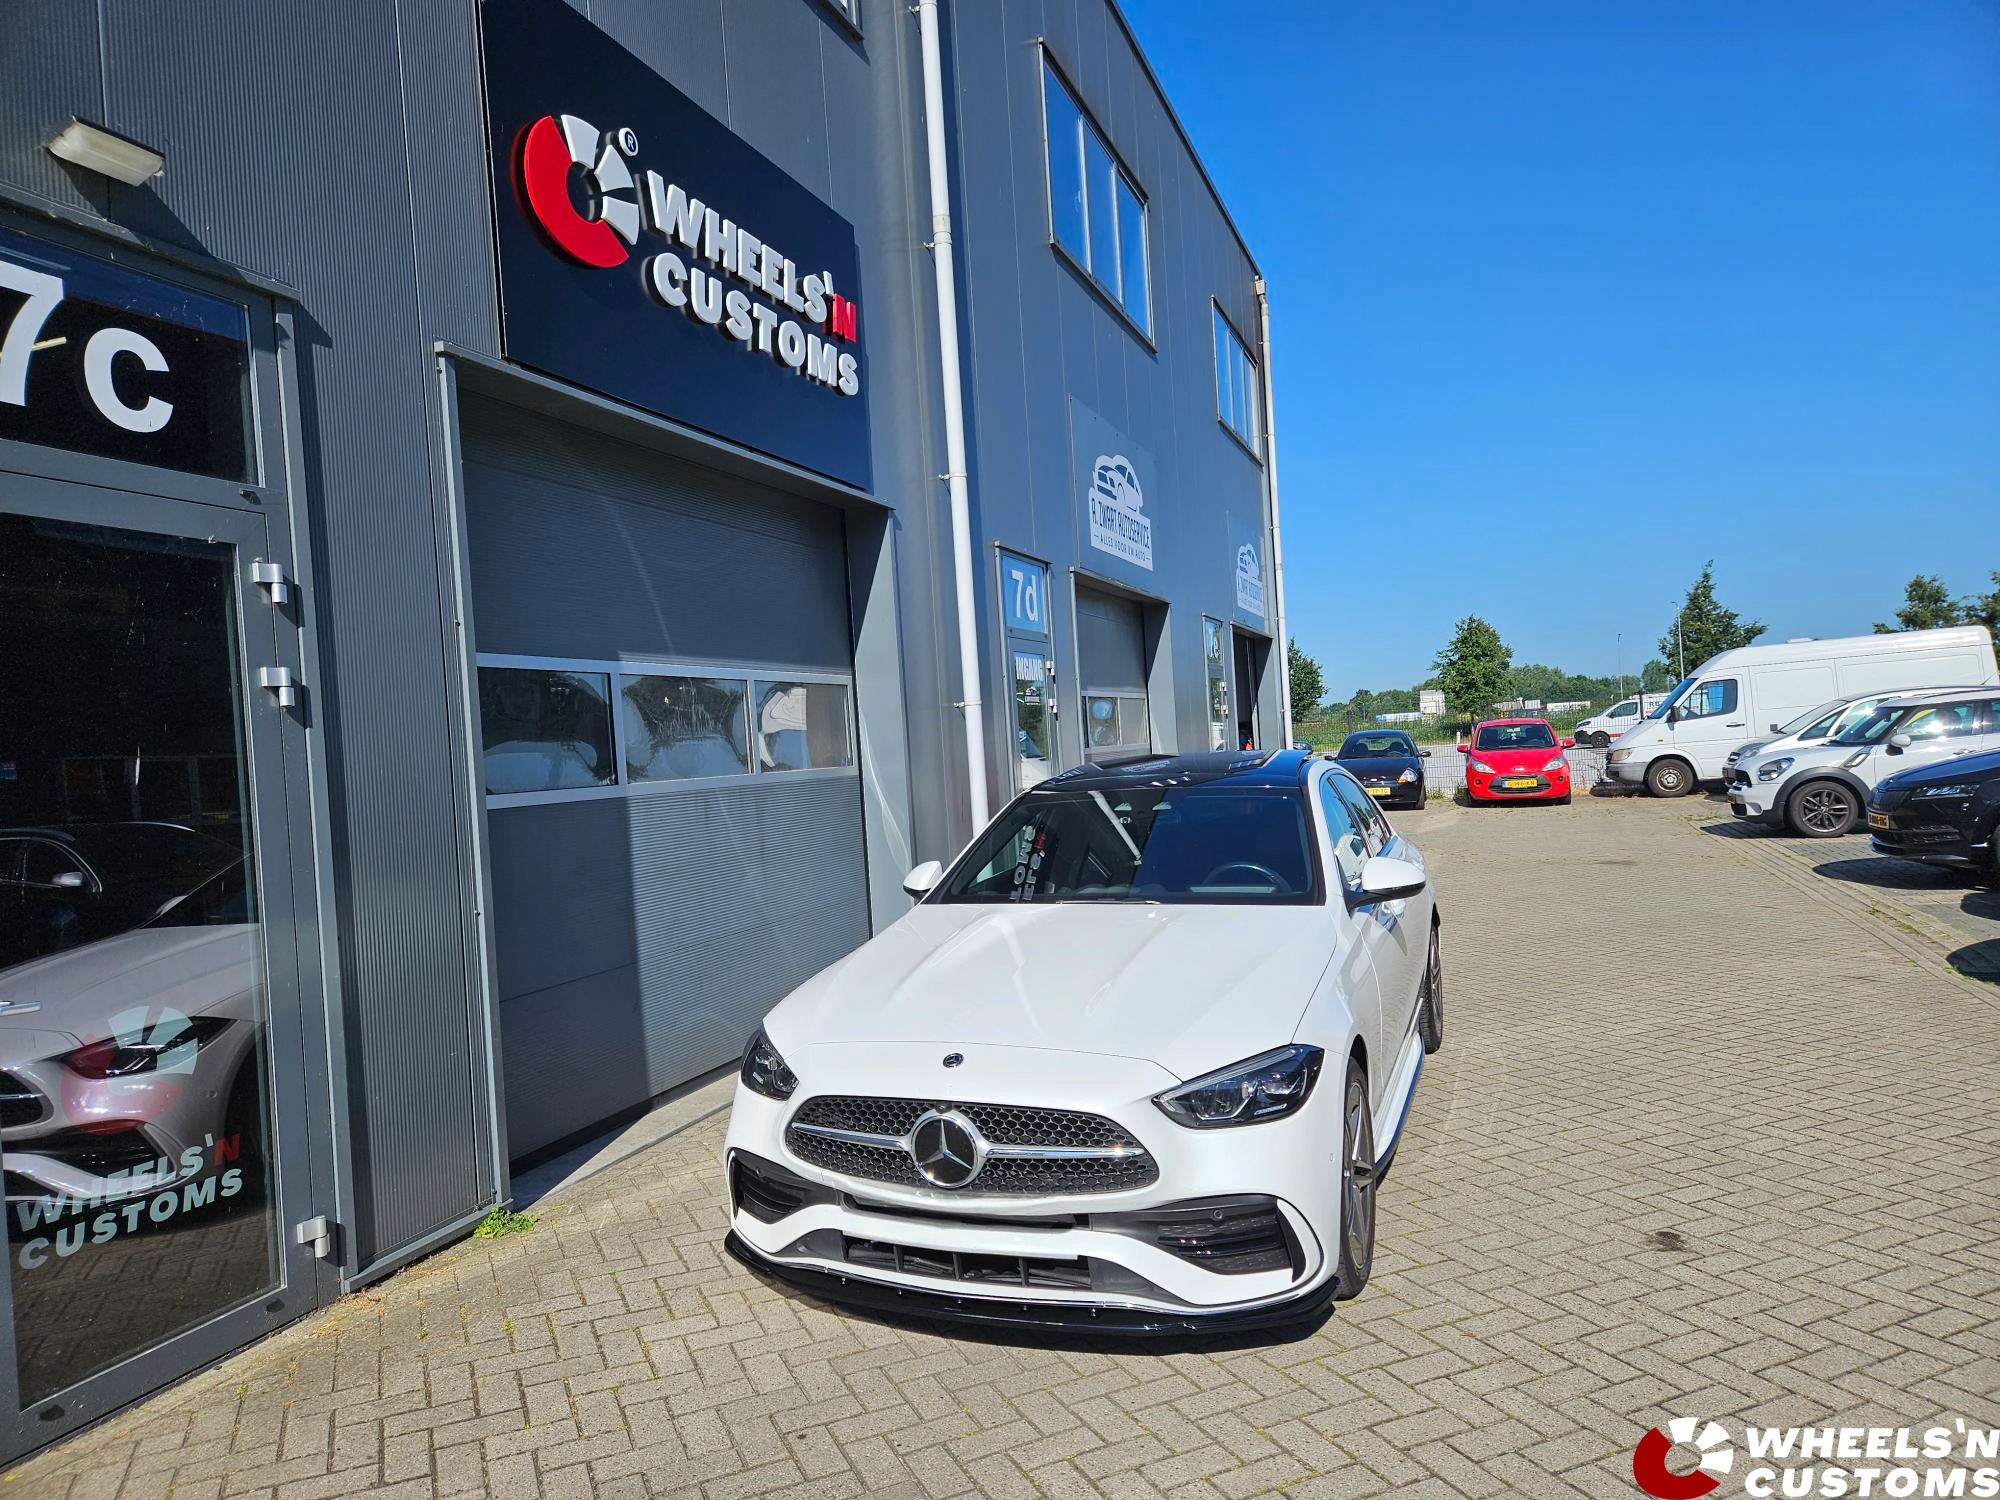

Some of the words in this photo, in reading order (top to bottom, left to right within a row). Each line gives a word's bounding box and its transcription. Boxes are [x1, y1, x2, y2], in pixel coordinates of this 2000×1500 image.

[653, 252, 858, 395] CUSTOMS
[1012, 569, 1038, 622] 7d
[19, 1168, 243, 1269] CUSTOMS
